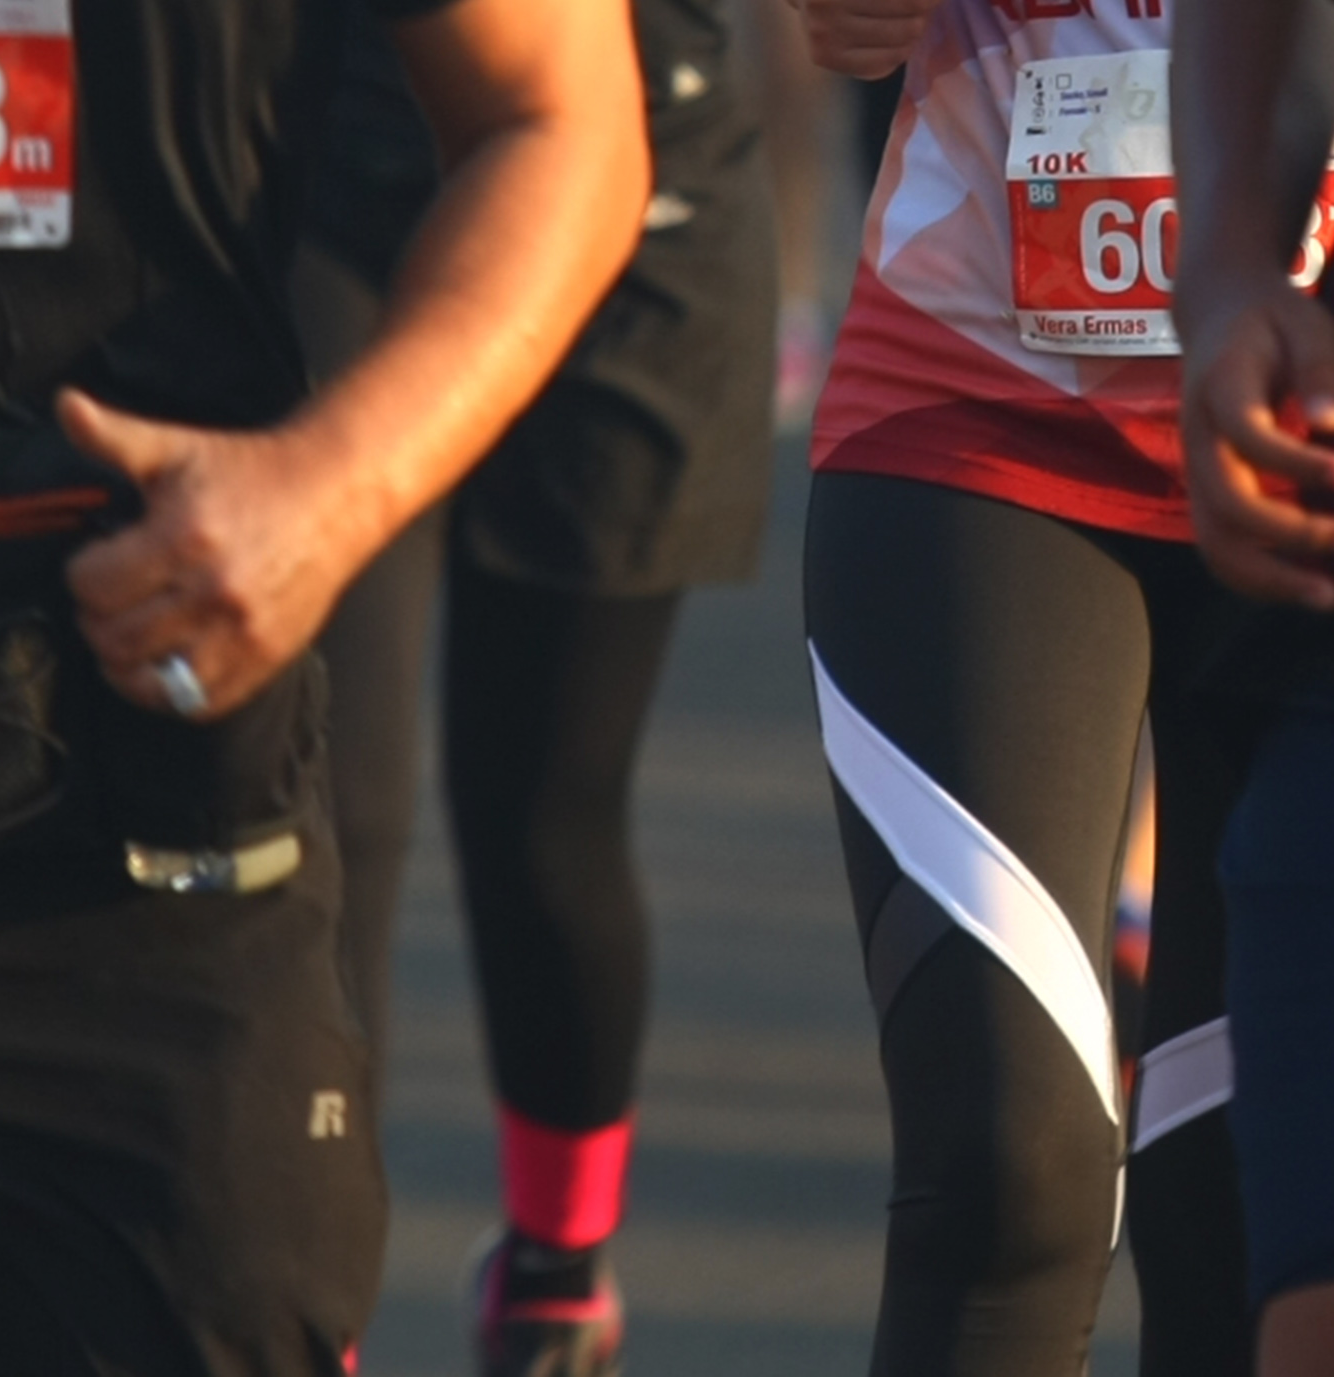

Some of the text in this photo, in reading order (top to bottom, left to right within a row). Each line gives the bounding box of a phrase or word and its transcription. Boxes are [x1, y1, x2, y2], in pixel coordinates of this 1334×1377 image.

[1027, 151, 1088, 175] 10K
[1028, 184, 1056, 204] B6
[1034, 315, 1148, 336] Vera Ermas
